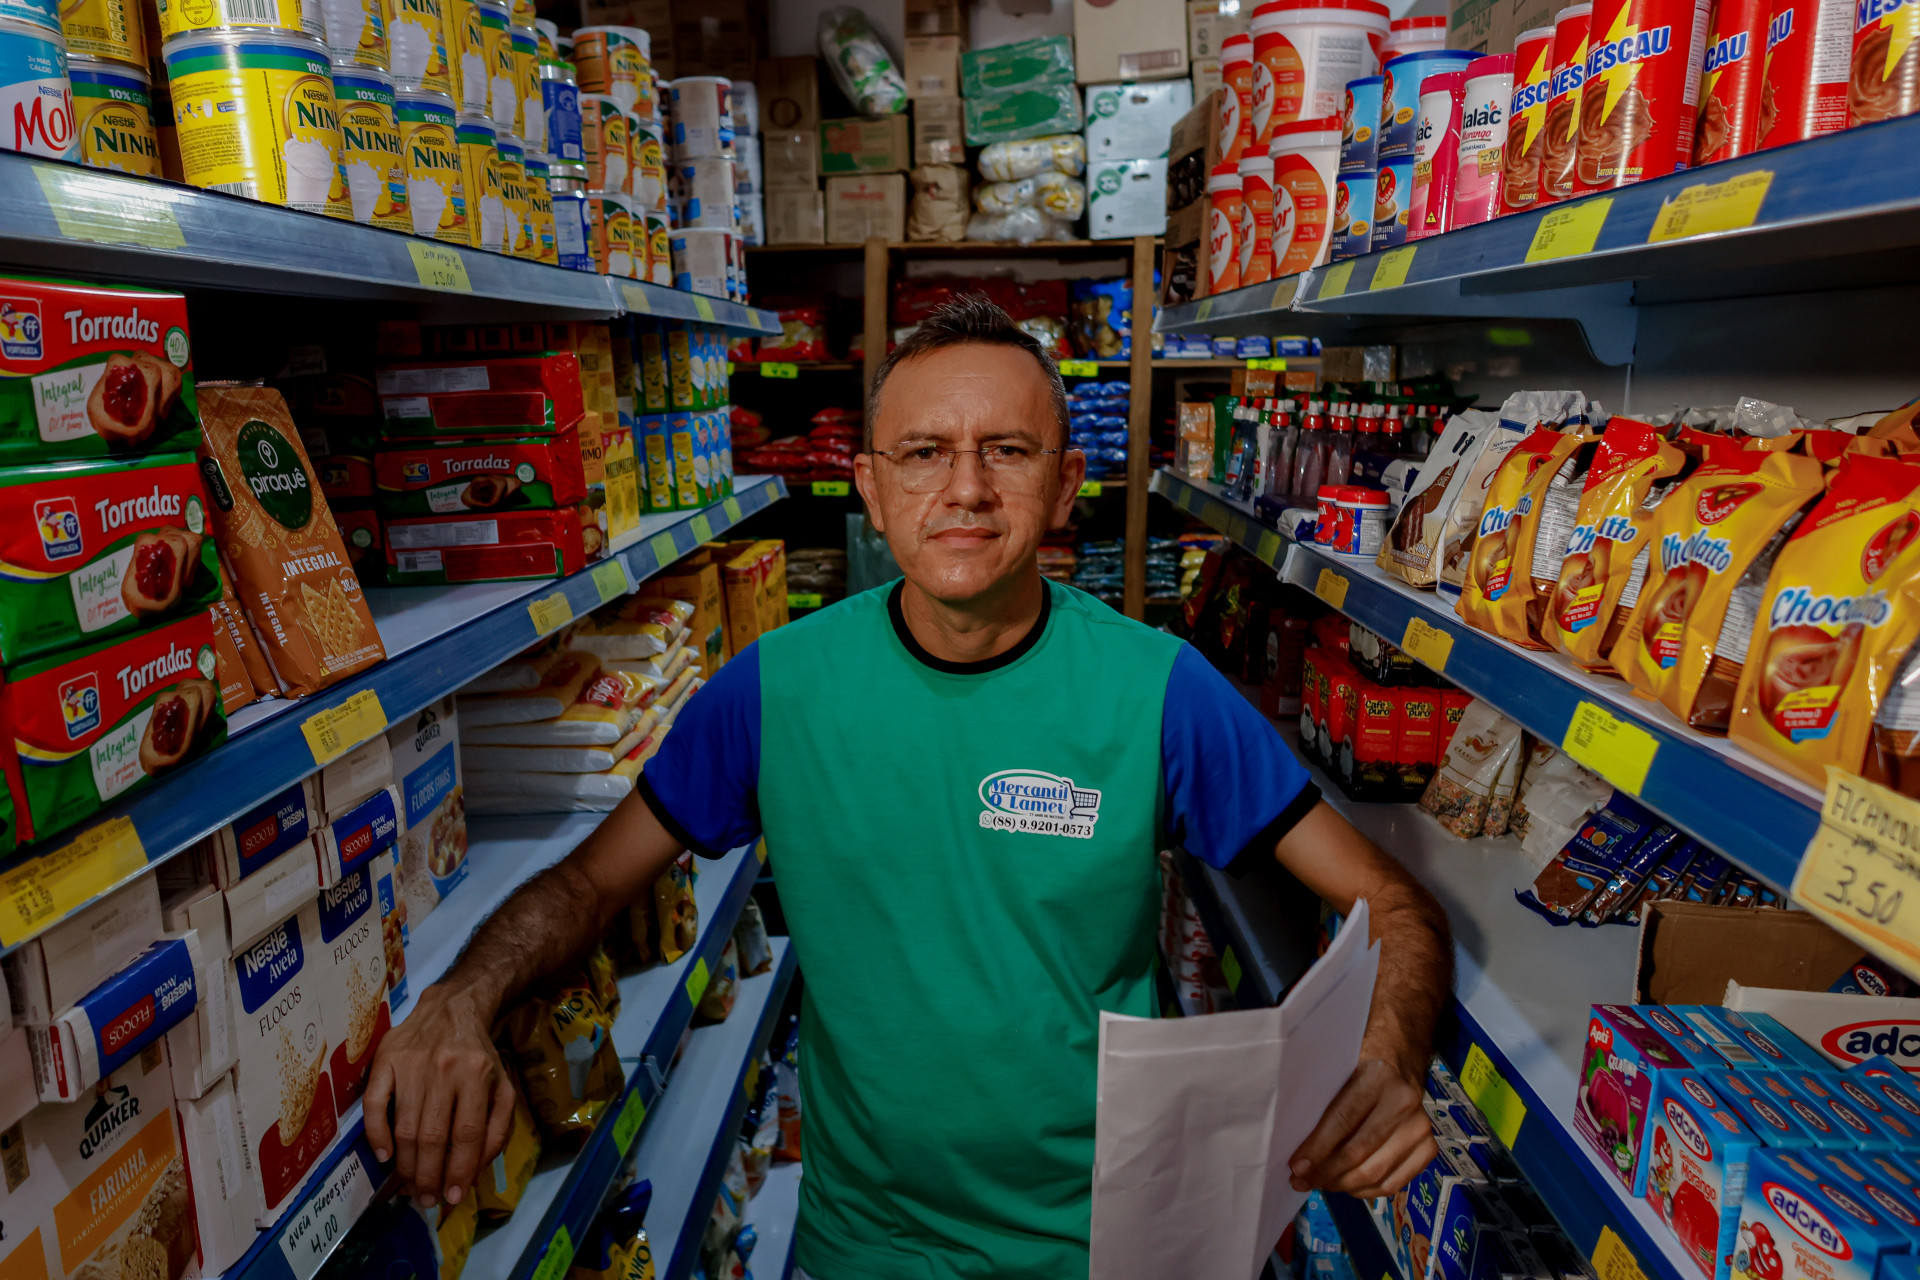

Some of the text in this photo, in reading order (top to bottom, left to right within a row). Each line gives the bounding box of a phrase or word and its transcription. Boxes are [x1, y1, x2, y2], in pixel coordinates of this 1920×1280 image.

[306, 62, 324, 75] 10%
[108, 89, 131, 101] 10%
[303, 89, 329, 103] Nestlé
[355, 89, 376, 101] 10%
[103, 115, 136, 128] Nestlé
[351, 115, 381, 127] Nestlé
[424, 113, 441, 123] 10%
[420, 136, 445, 146] Nestlé
[64, 307, 159, 344] Torradas
[40, 373, 86, 408] Integral
[442, 454, 511, 475] Torradas
[249, 467, 306, 500] piraquê
[95, 485, 181, 533] Torradas
[78, 559, 120, 599] Integral
[281, 551, 342, 577] INTEGRAL
[218, 600, 246, 651] INTEGRAL
[258, 592, 288, 648] INTEGRAL
[117, 642, 192, 700] Torradas
[1365, 700, 1385, 711] Café
[1368, 707, 1390, 717] puro
[1405, 702, 1427, 712] Café
[1408, 709, 1431, 718] puro
[96, 724, 137, 771] Integral
[414, 725, 441, 753] QUAKER
[990, 779, 1068, 800] Mercantil
[245, 822, 275, 851] FLOCOS
[992, 816, 1092, 836] (88) 9.9201-0573
[345, 831, 370, 857] FLOCOS
[343, 888, 368, 920] Aveia
[1823, 865, 1904, 925] 3.50
[243, 923, 292, 979] Nestlé
[333, 922, 370, 962] FLOCOS
[269, 947, 298, 984] Aveia
[154, 974, 177, 998] Aveia
[161, 977, 193, 1012] Nestlé
[109, 1005, 151, 1046] FLOCOS
[259, 985, 304, 1038] FLOCOS
[1590, 1025, 1610, 1045] Apti
[79, 1097, 140, 1160] QUAKER
[1668, 1104, 1706, 1160] adorel
[89, 1149, 147, 1215] FARINHA
[1681, 1161, 1717, 1201] Morango
[311, 1214, 338, 1254] 4.00
[1771, 1190, 1839, 1252] adorel
